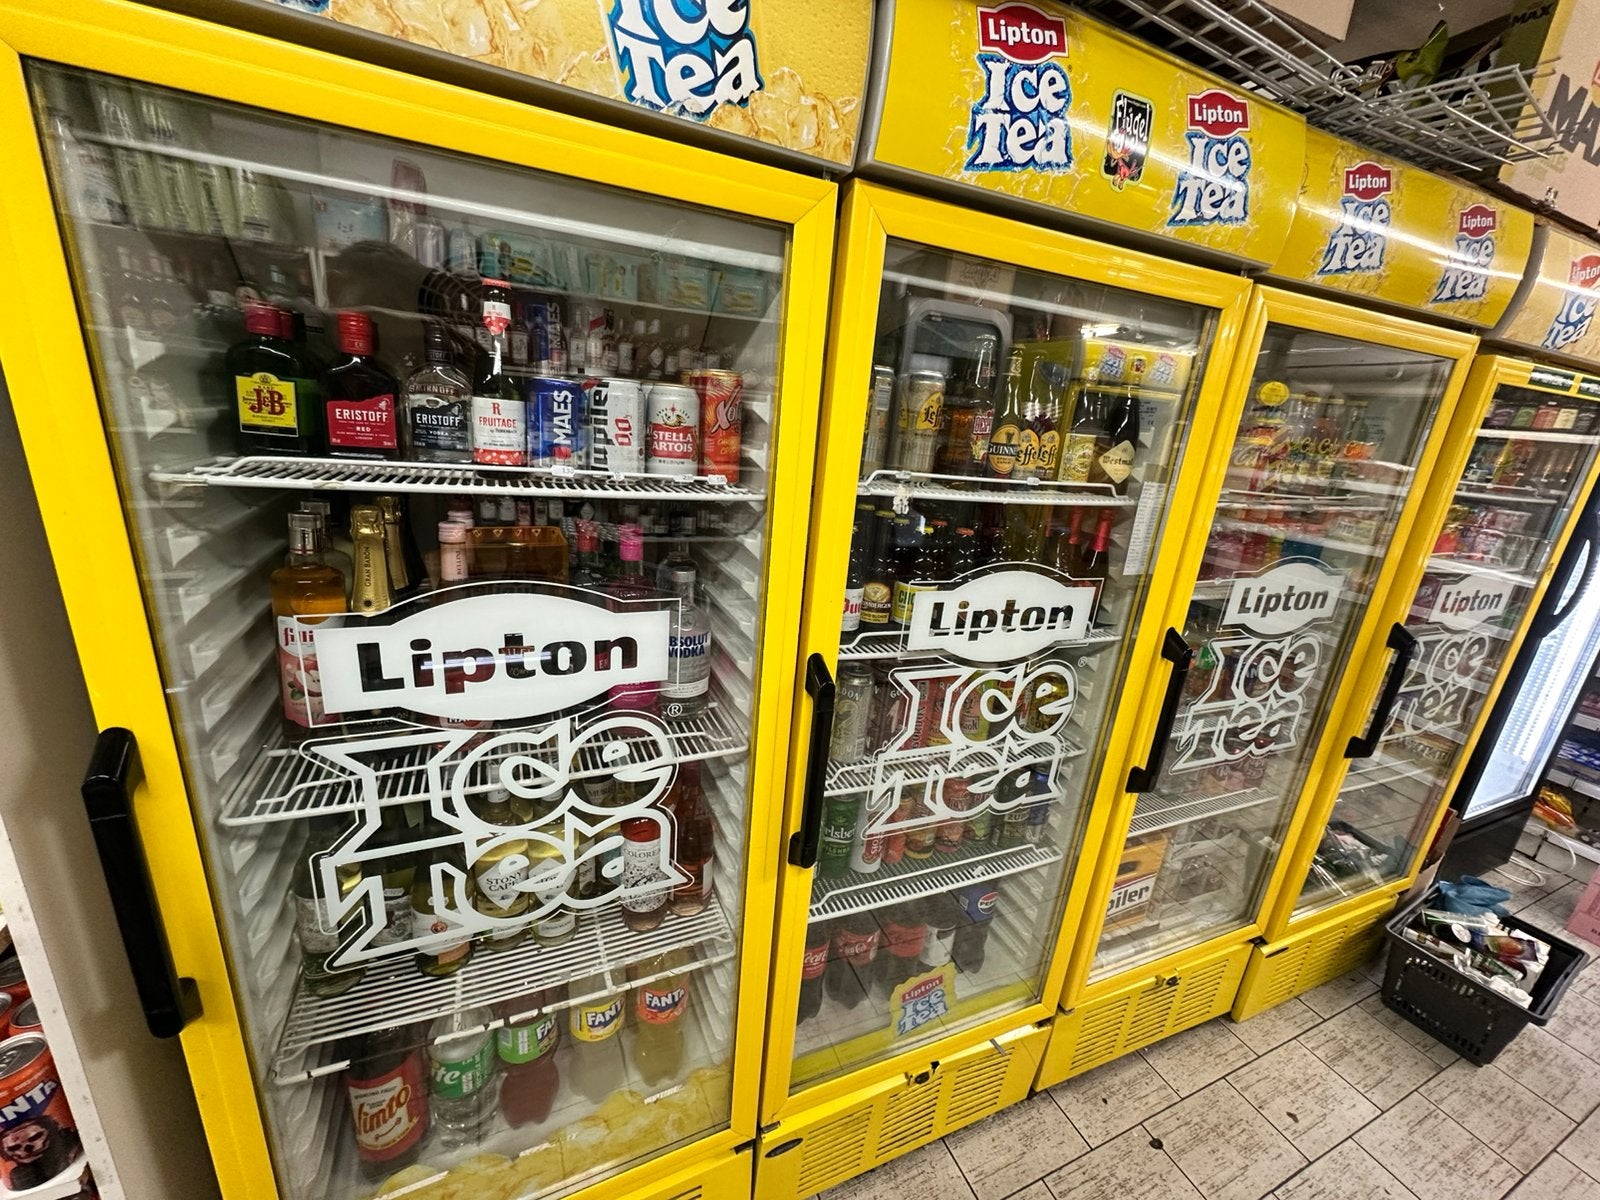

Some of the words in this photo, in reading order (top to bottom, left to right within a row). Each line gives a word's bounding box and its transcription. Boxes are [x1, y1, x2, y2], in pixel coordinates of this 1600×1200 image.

[1511, 5, 1553, 25] MAX
[988, 18, 1058, 46] Lipton
[980, 57, 1070, 114] Ice
[1194, 102, 1244, 124] Lipton
[971, 112, 1070, 167] Tea
[1189, 136, 1251, 178] Ice
[1348, 173, 1388, 190] Lipton
[1174, 178, 1249, 222] Tea
[1338, 199, 1391, 236] Ice
[1461, 213, 1494, 229] Lipton
[1322, 234, 1385, 274] Tea
[1455, 237, 1494, 267] Ice
[1433, 268, 1487, 301] Tea
[249, 388, 286, 416] J&B
[409, 384, 455, 395] SMIRNOFF
[336, 408, 389, 423] ERISTOFF
[416, 413, 461, 427] ERISTOFF
[479, 416, 518, 429] FRUITAGE
[491, 402, 502, 416] R
[553, 389, 573, 446] MAES
[652, 429, 693, 443] STELLA
[652, 442, 693, 453] ARTOIS
[658, 458, 686, 466] BELGIUM
[364, 567, 372, 588] GRAN
[1237, 585, 1329, 618] Lipton
[1440, 589, 1503, 616] Lipton
[929, 598, 1075, 642] Lipton
[668, 632, 709, 648] BSOLUT
[355, 632, 639, 696] Lipton
[903, 989, 946, 1016] Ice
[904, 978, 941, 1000] Lipton
